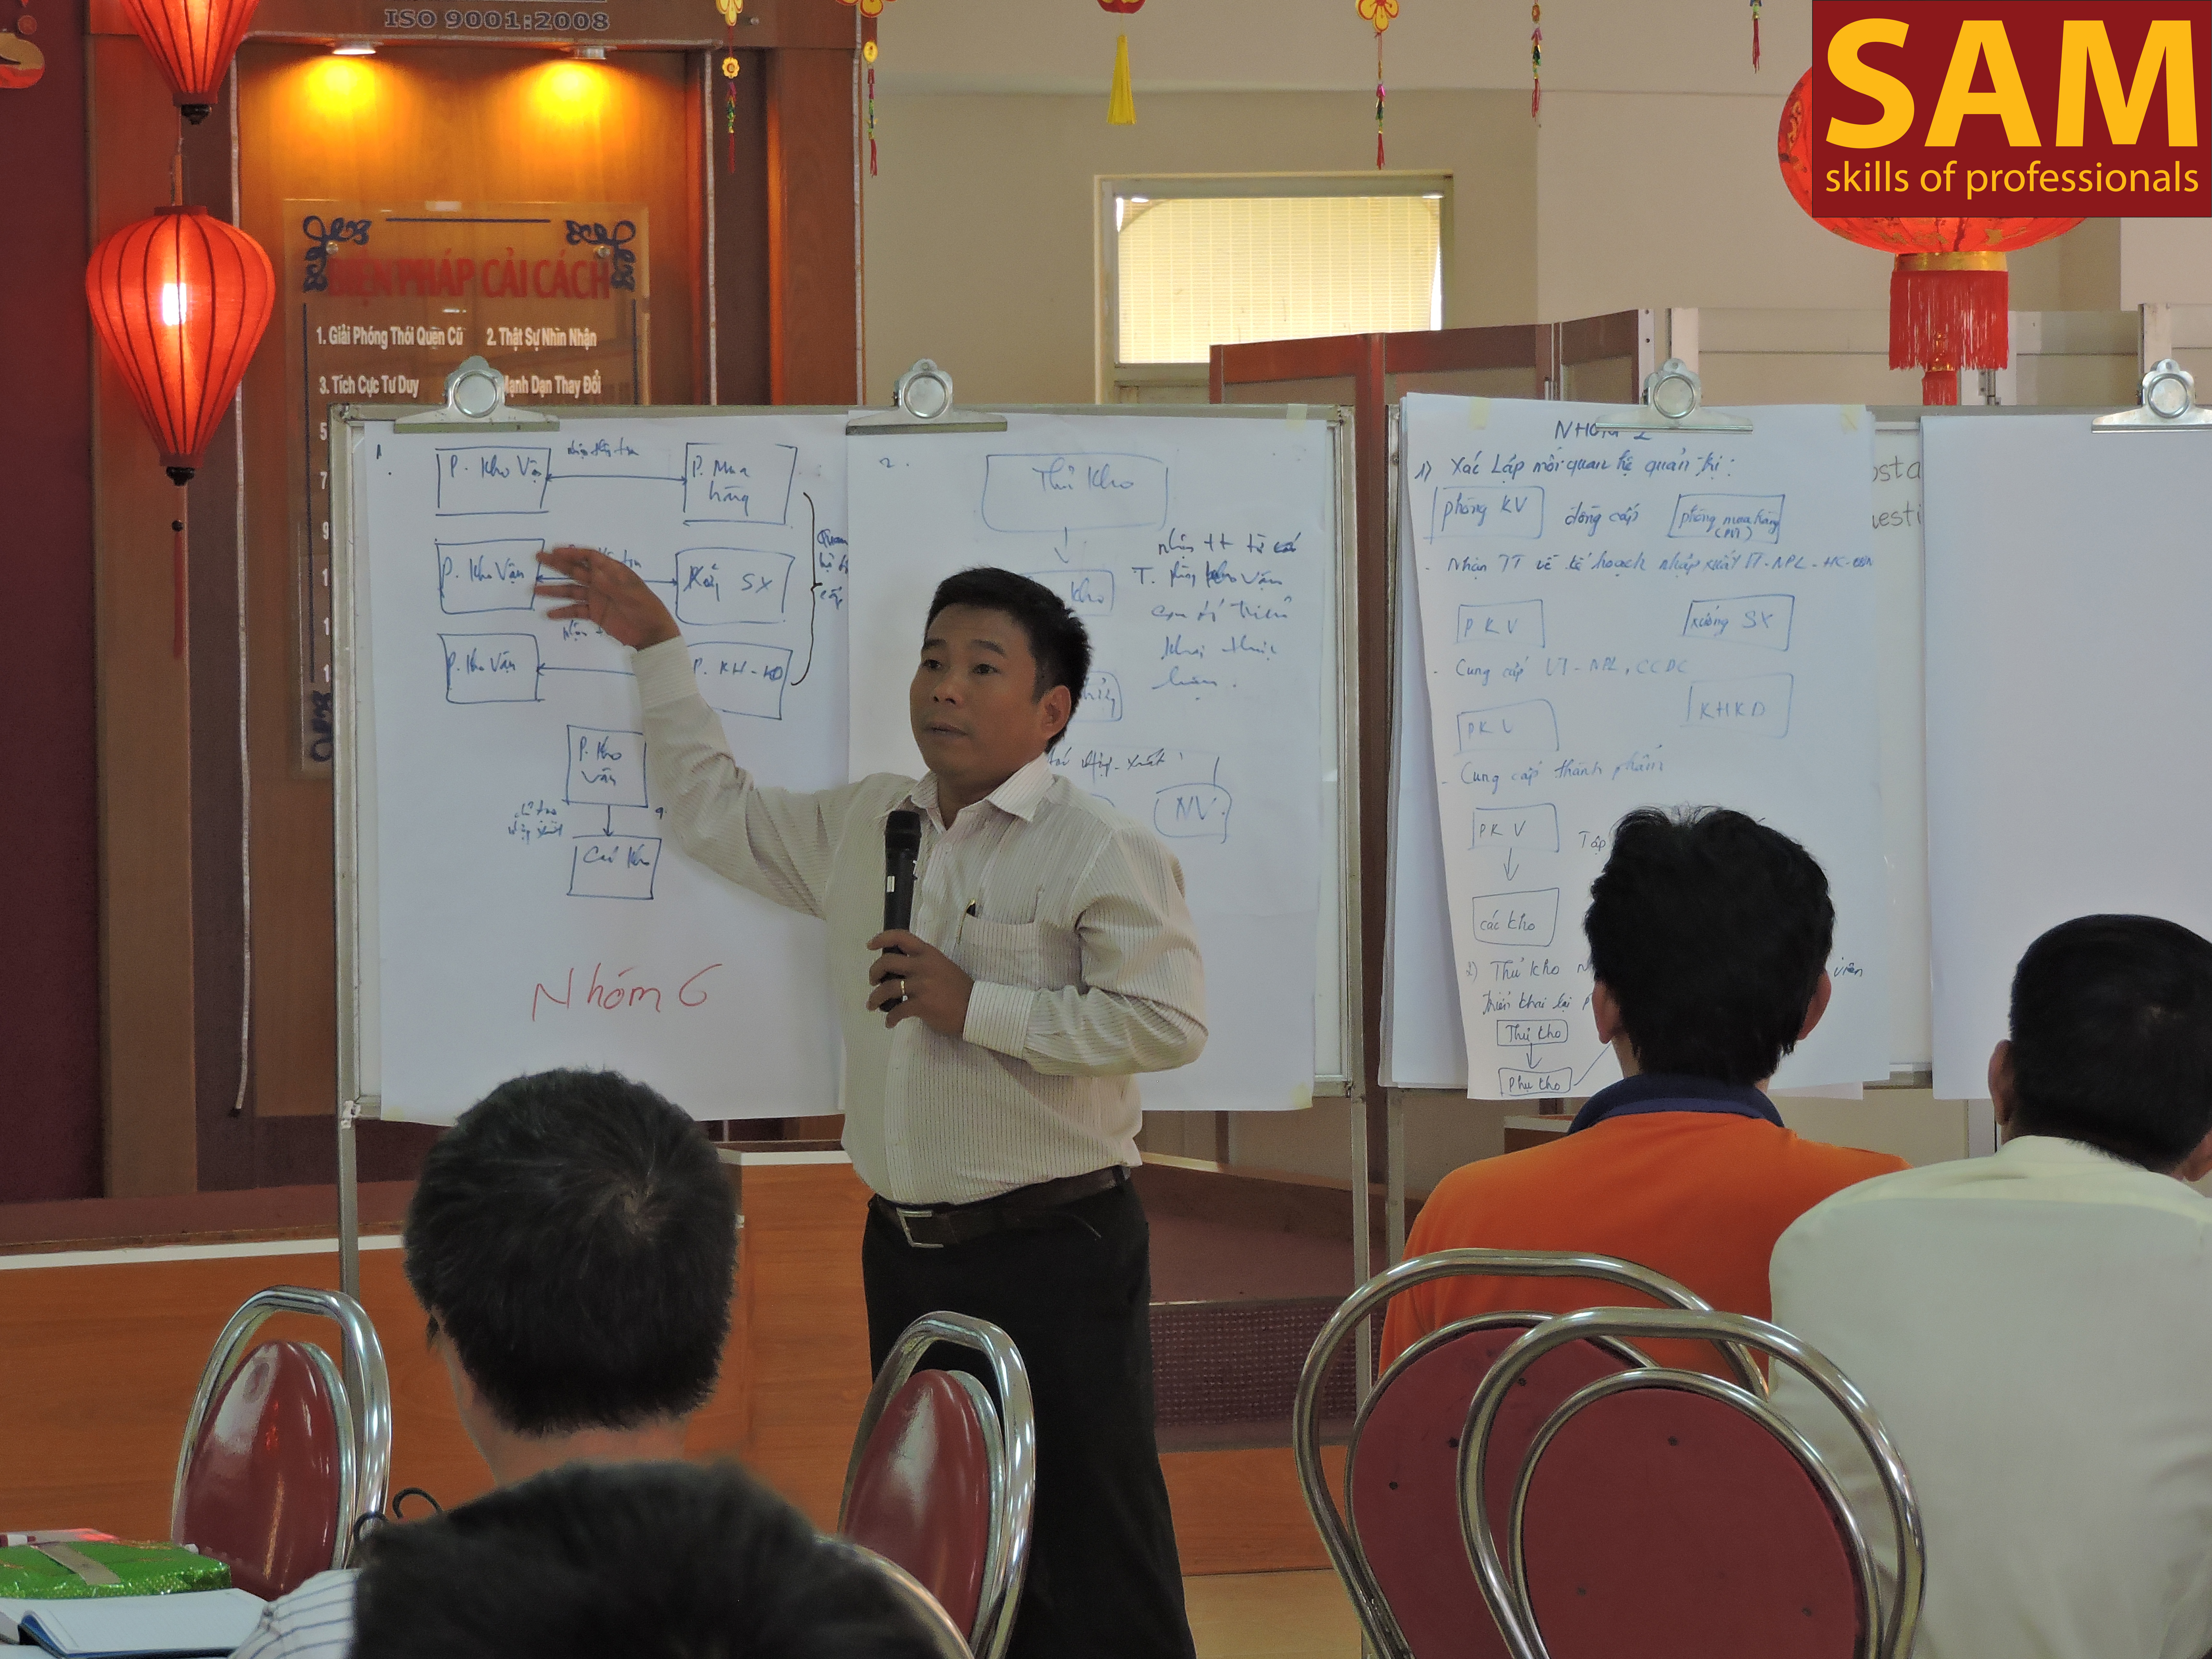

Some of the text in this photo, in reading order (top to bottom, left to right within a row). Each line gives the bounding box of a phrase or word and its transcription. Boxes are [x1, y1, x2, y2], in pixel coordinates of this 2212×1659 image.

[385, 9, 610, 31] ISO 9001:2008
[483, 246, 528, 298] CẢI
[533, 249, 610, 299] CÁCH
[317, 326, 326, 345] 1.
[328, 324, 350, 345] Giải
[353, 325, 388, 350] Phóng
[525, 327, 540, 351] Sự
[569, 327, 597, 350] Nhận
[319, 376, 330, 394] 3.
[332, 374, 356, 394] Tích
[358, 375, 379, 397] Cực
[398, 375, 419, 398] Duy
[554, 375, 581, 398] Thay
[532, 962, 723, 1022] Nhóm 6
